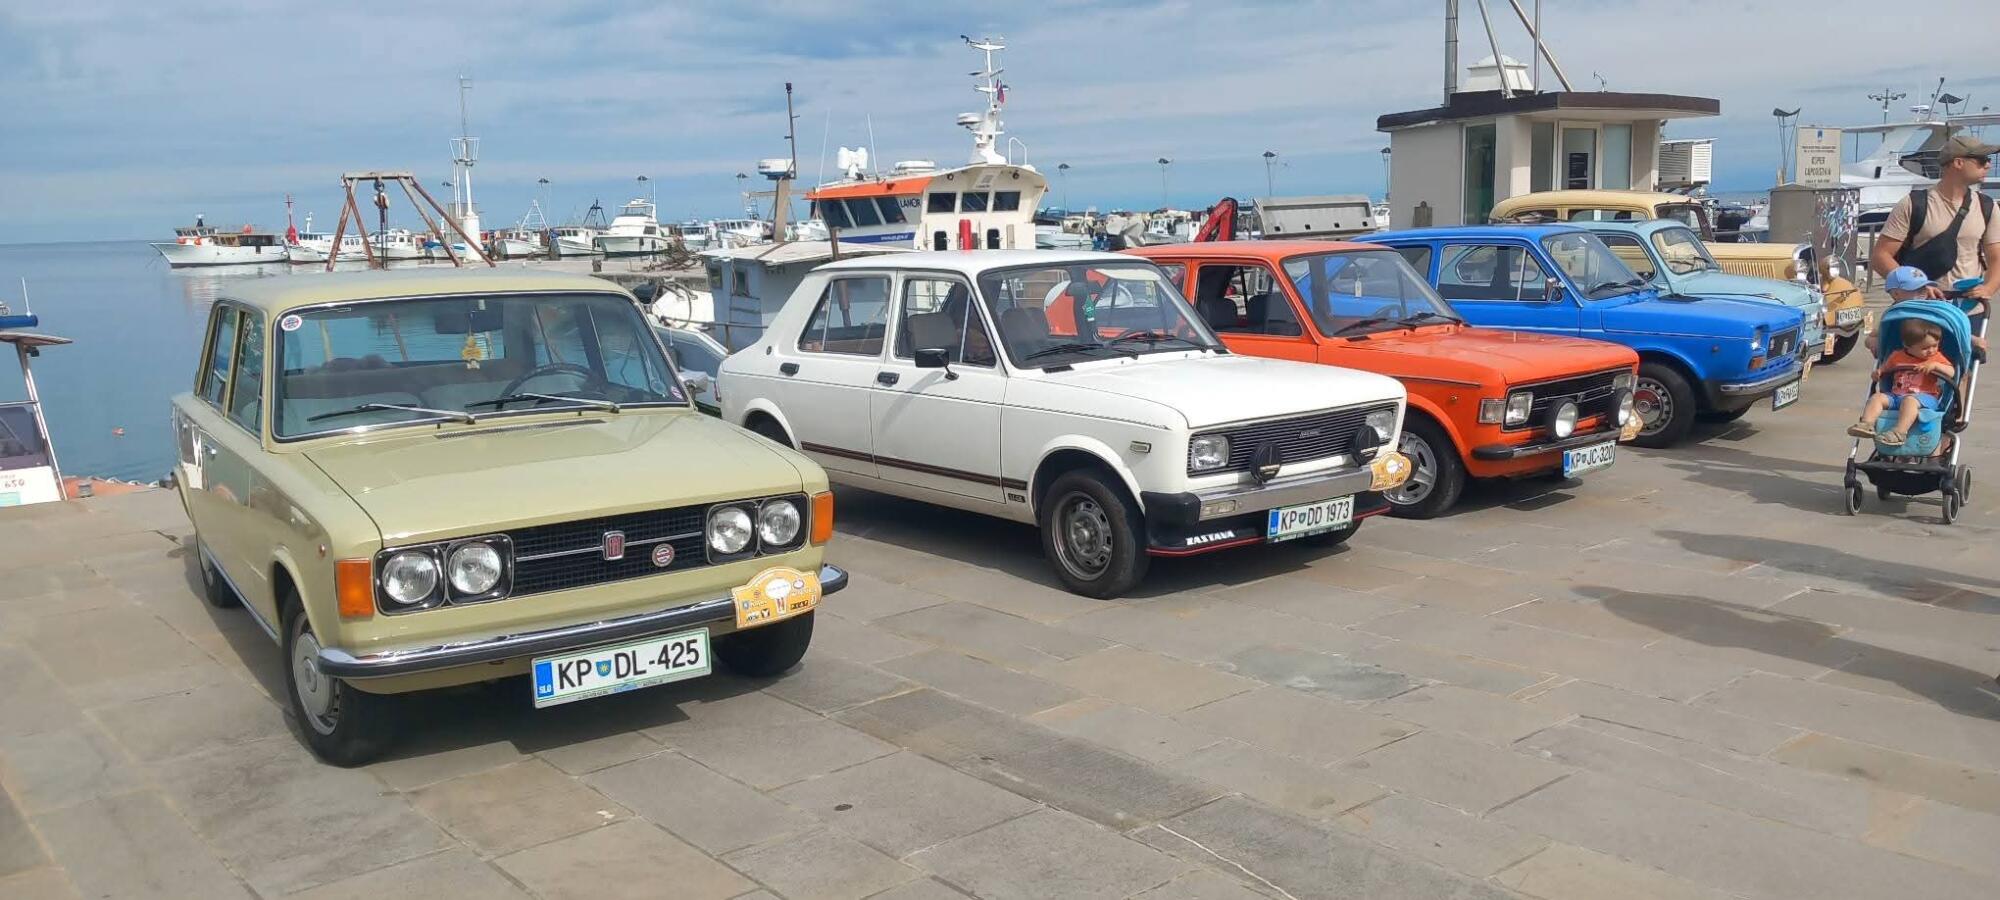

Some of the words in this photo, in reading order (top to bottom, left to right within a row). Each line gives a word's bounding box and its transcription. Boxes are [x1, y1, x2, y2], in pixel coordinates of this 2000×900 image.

[900, 198, 921, 208] LAMOR
[1571, 452, 1581, 469] KP
[4, 479, 25, 488] 650
[1281, 510, 1298, 531] KP
[1307, 506, 1322, 526] DD
[1326, 500, 1350, 523] 1973
[1186, 530, 1235, 546] ZASTAVA
[558, 657, 592, 690] KP
[614, 639, 699, 679] DL-425
[538, 684, 551, 694] SLO
